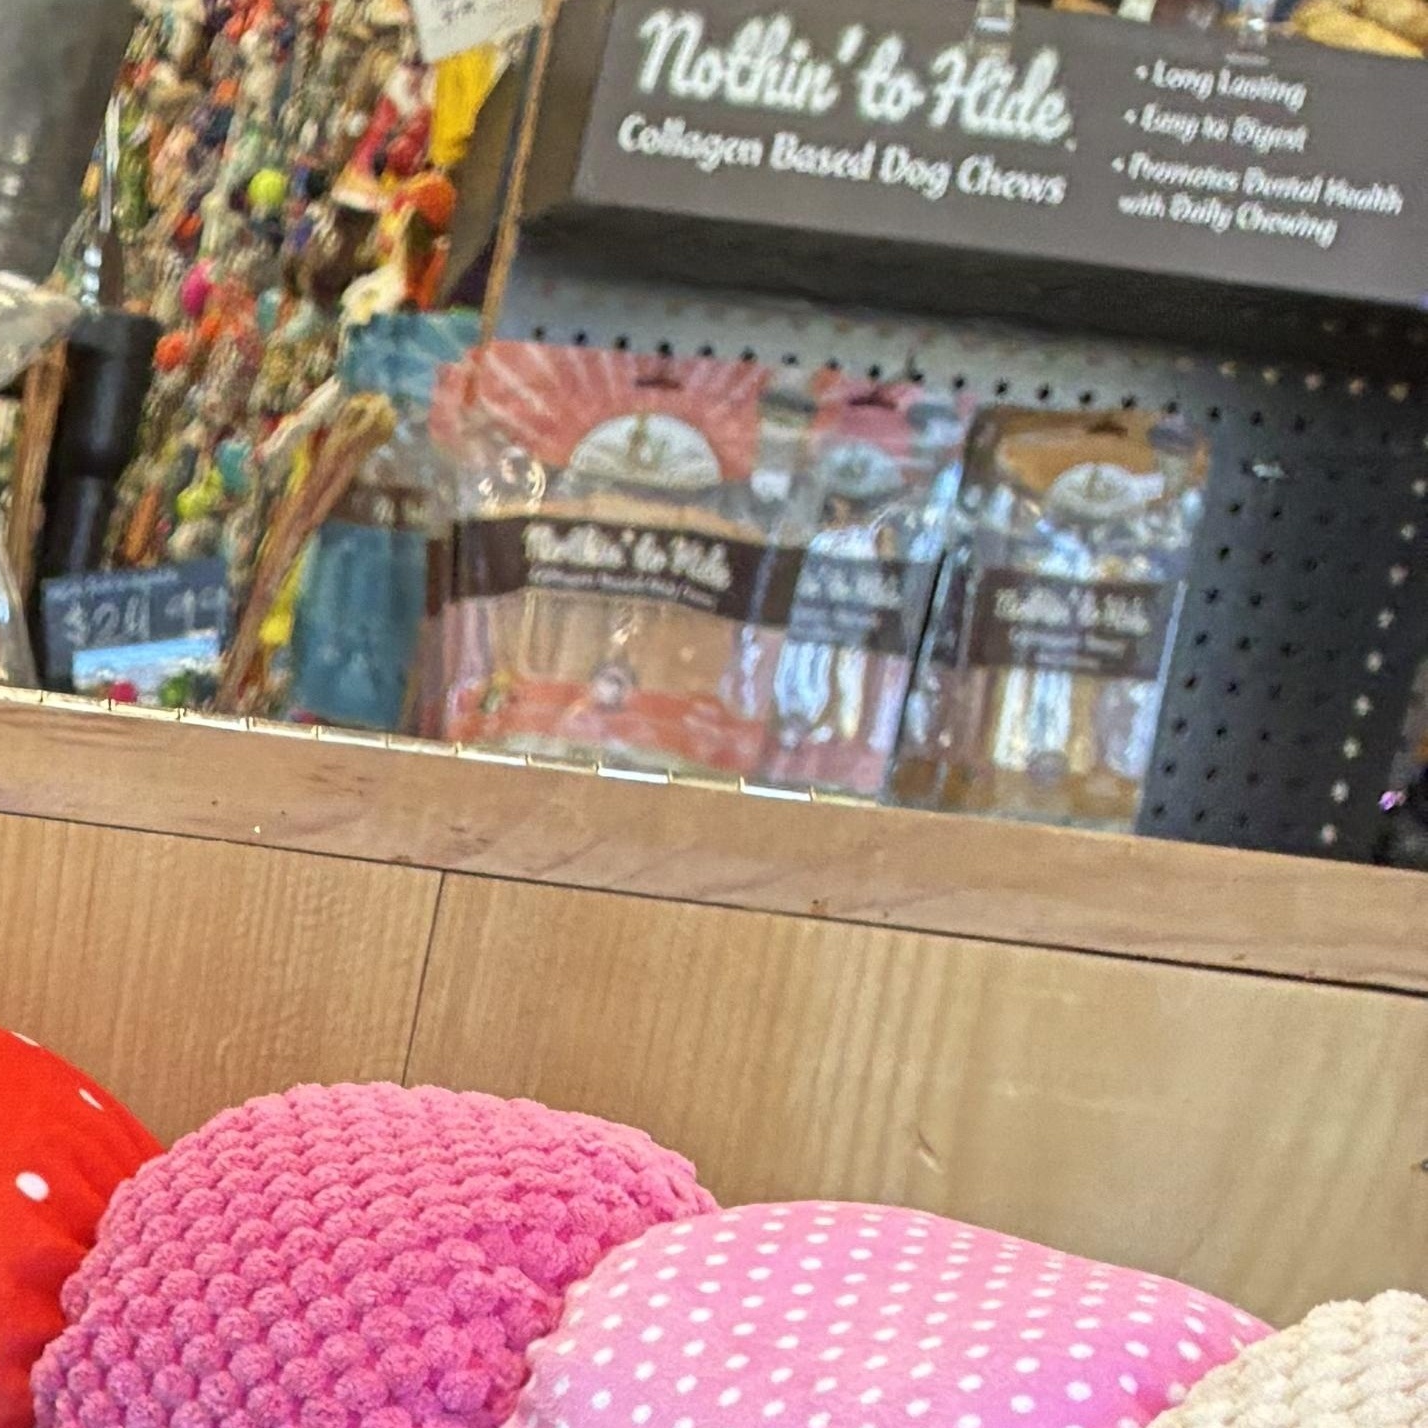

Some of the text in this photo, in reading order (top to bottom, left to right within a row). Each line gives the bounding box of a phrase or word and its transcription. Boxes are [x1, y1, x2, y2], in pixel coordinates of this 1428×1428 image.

[640, 9, 865, 115] Nothin'
[857, 33, 926, 122] to
[1152, 58, 1308, 113] Long Lasting
[1201, 113, 1229, 141] to
[617, 112, 1068, 205] Collagen Based Dog Chews
[1128, 151, 1404, 216] Promotes Dental Health
[1118, 192, 1339, 250] with Daily Chewing
